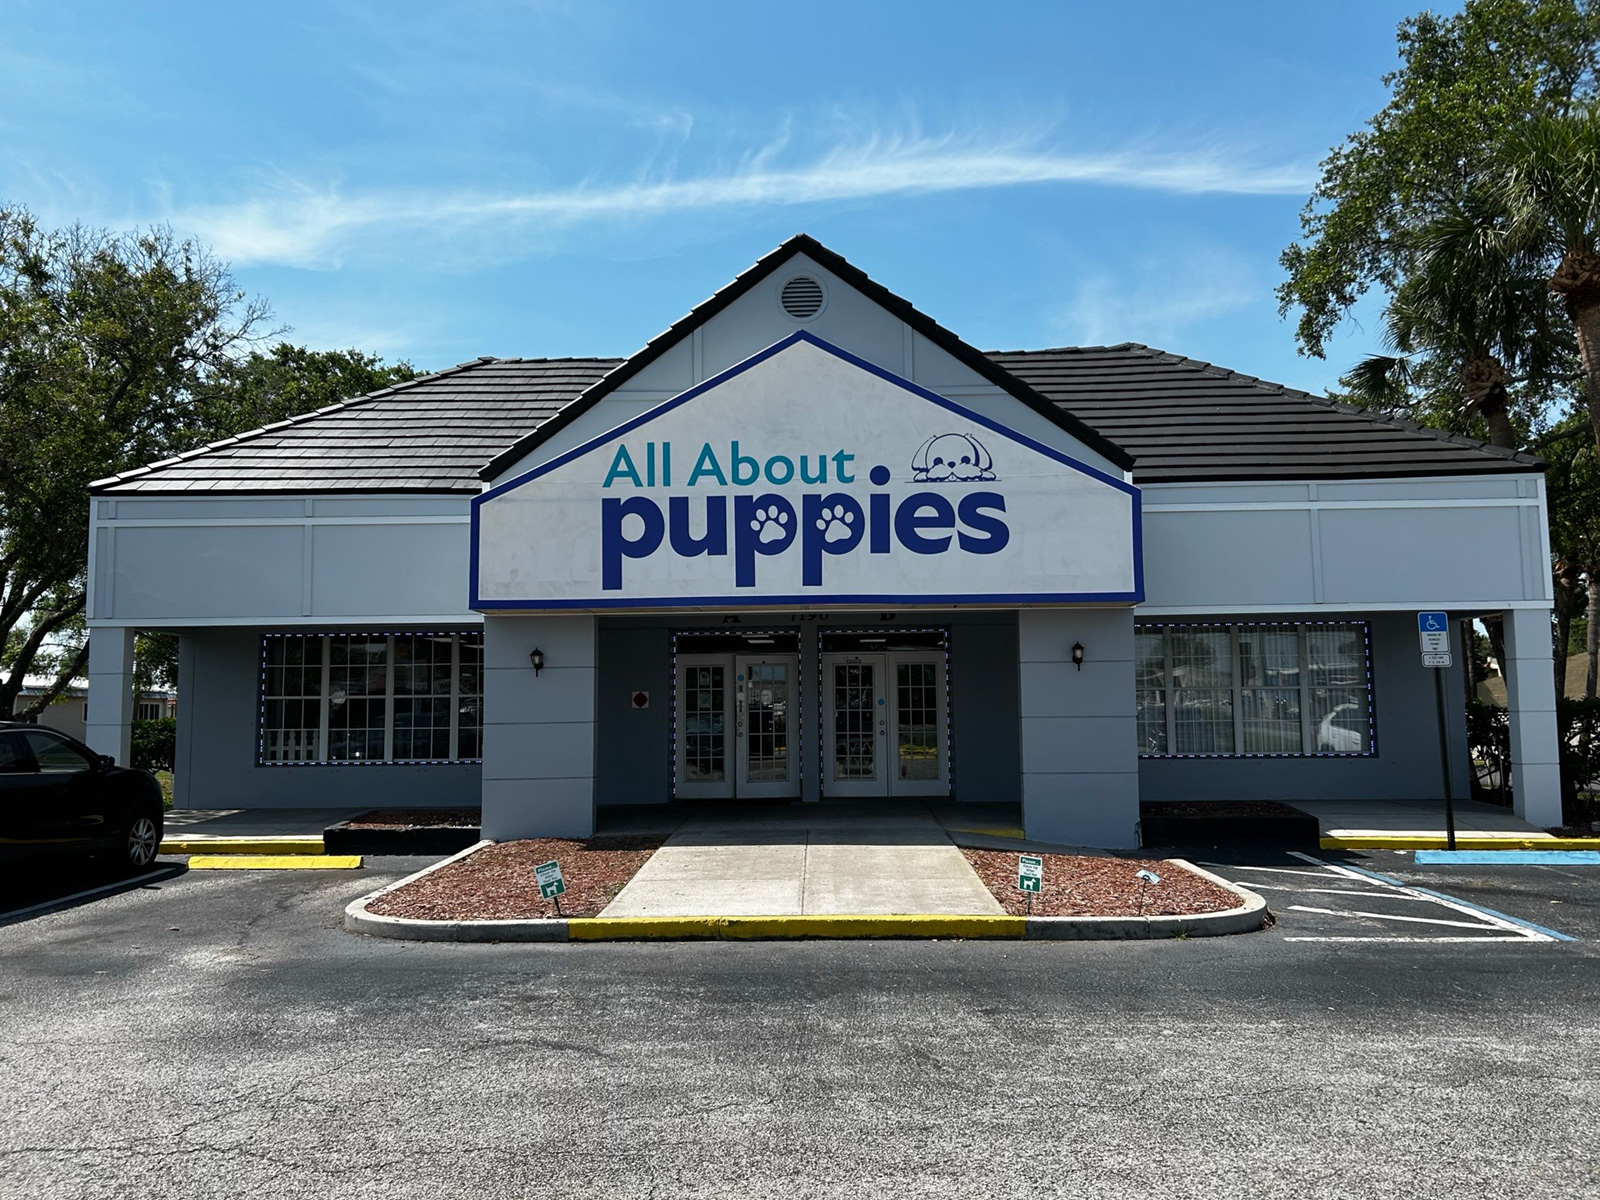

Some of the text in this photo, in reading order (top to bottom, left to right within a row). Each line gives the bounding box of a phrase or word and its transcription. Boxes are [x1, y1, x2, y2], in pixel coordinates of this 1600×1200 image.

[602, 440, 855, 487] All About
[602, 465, 1010, 590] puppies
